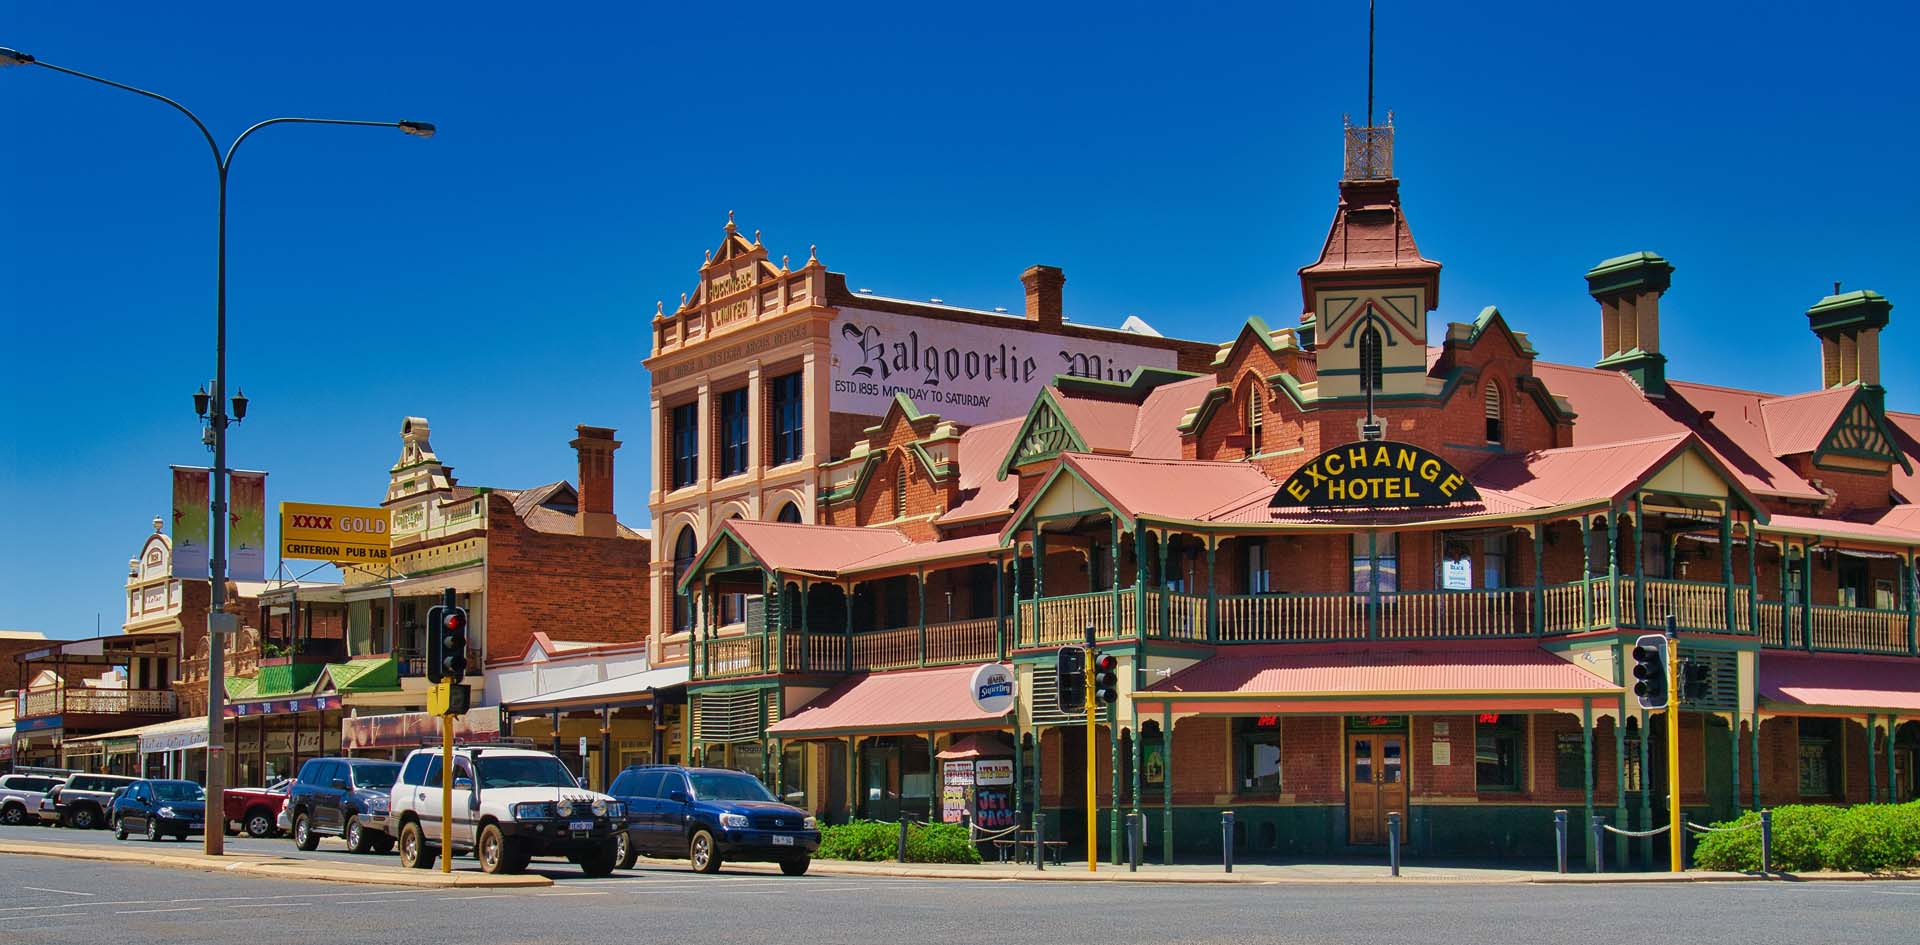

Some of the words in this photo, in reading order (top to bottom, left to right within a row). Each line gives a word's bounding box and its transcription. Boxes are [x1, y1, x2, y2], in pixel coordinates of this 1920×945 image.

[842, 322, 1037, 386] Kalgoorlie
[882, 385, 930, 402] MONDAY
[931, 389, 943, 402] TO
[945, 391, 991, 407] SATURDAY
[1287, 446, 1465, 502] EXCHANGE
[1328, 477, 1420, 500] HOTEL
[291, 514, 334, 530] XXXX
[340, 516, 386, 534] GOLD
[287, 543, 340, 557] CRITERION
[346, 546, 367, 558] PUB
[369, 548, 388, 559] TAB
[979, 790, 1007, 810] JET
[977, 809, 1013, 827] PACK
